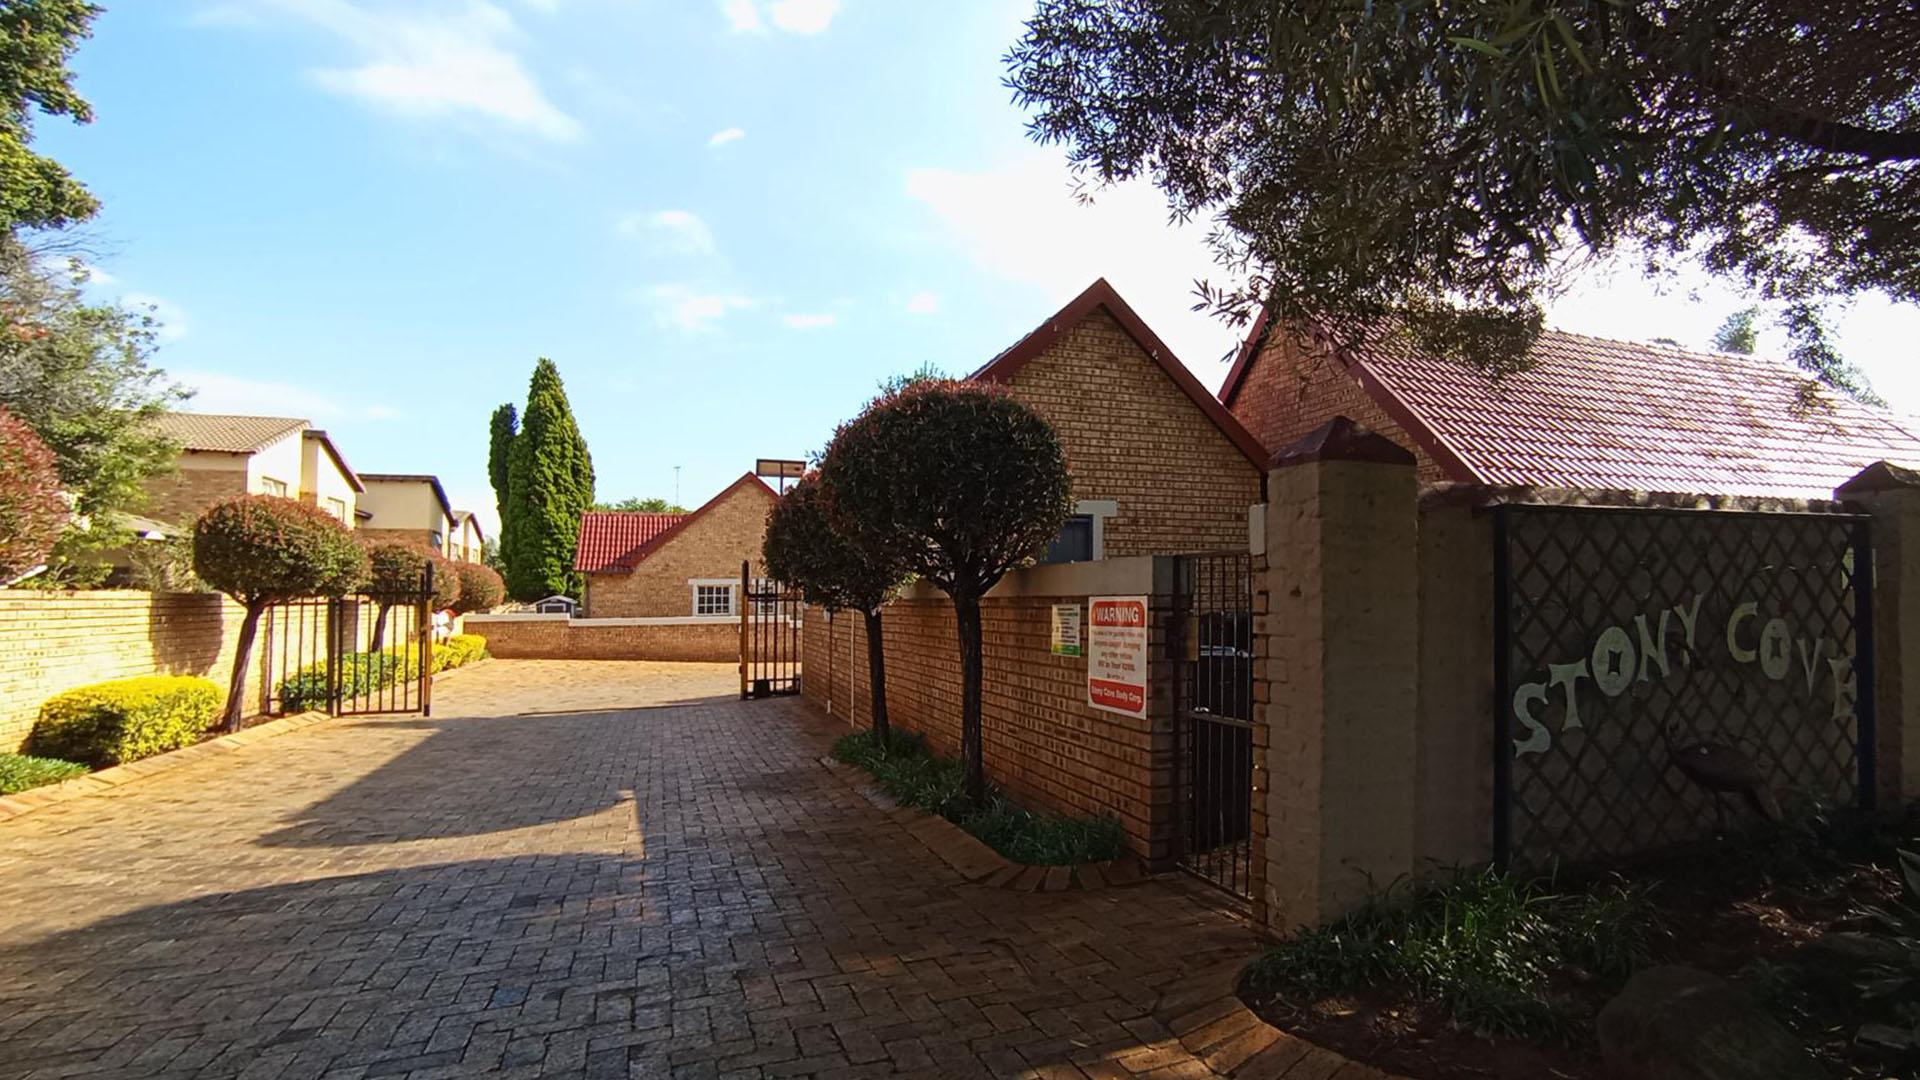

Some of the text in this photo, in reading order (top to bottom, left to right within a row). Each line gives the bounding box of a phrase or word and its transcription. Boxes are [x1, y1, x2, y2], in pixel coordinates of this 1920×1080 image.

[1096, 606, 1139, 623] WARNING
[1512, 594, 1857, 759] STONY COVE
